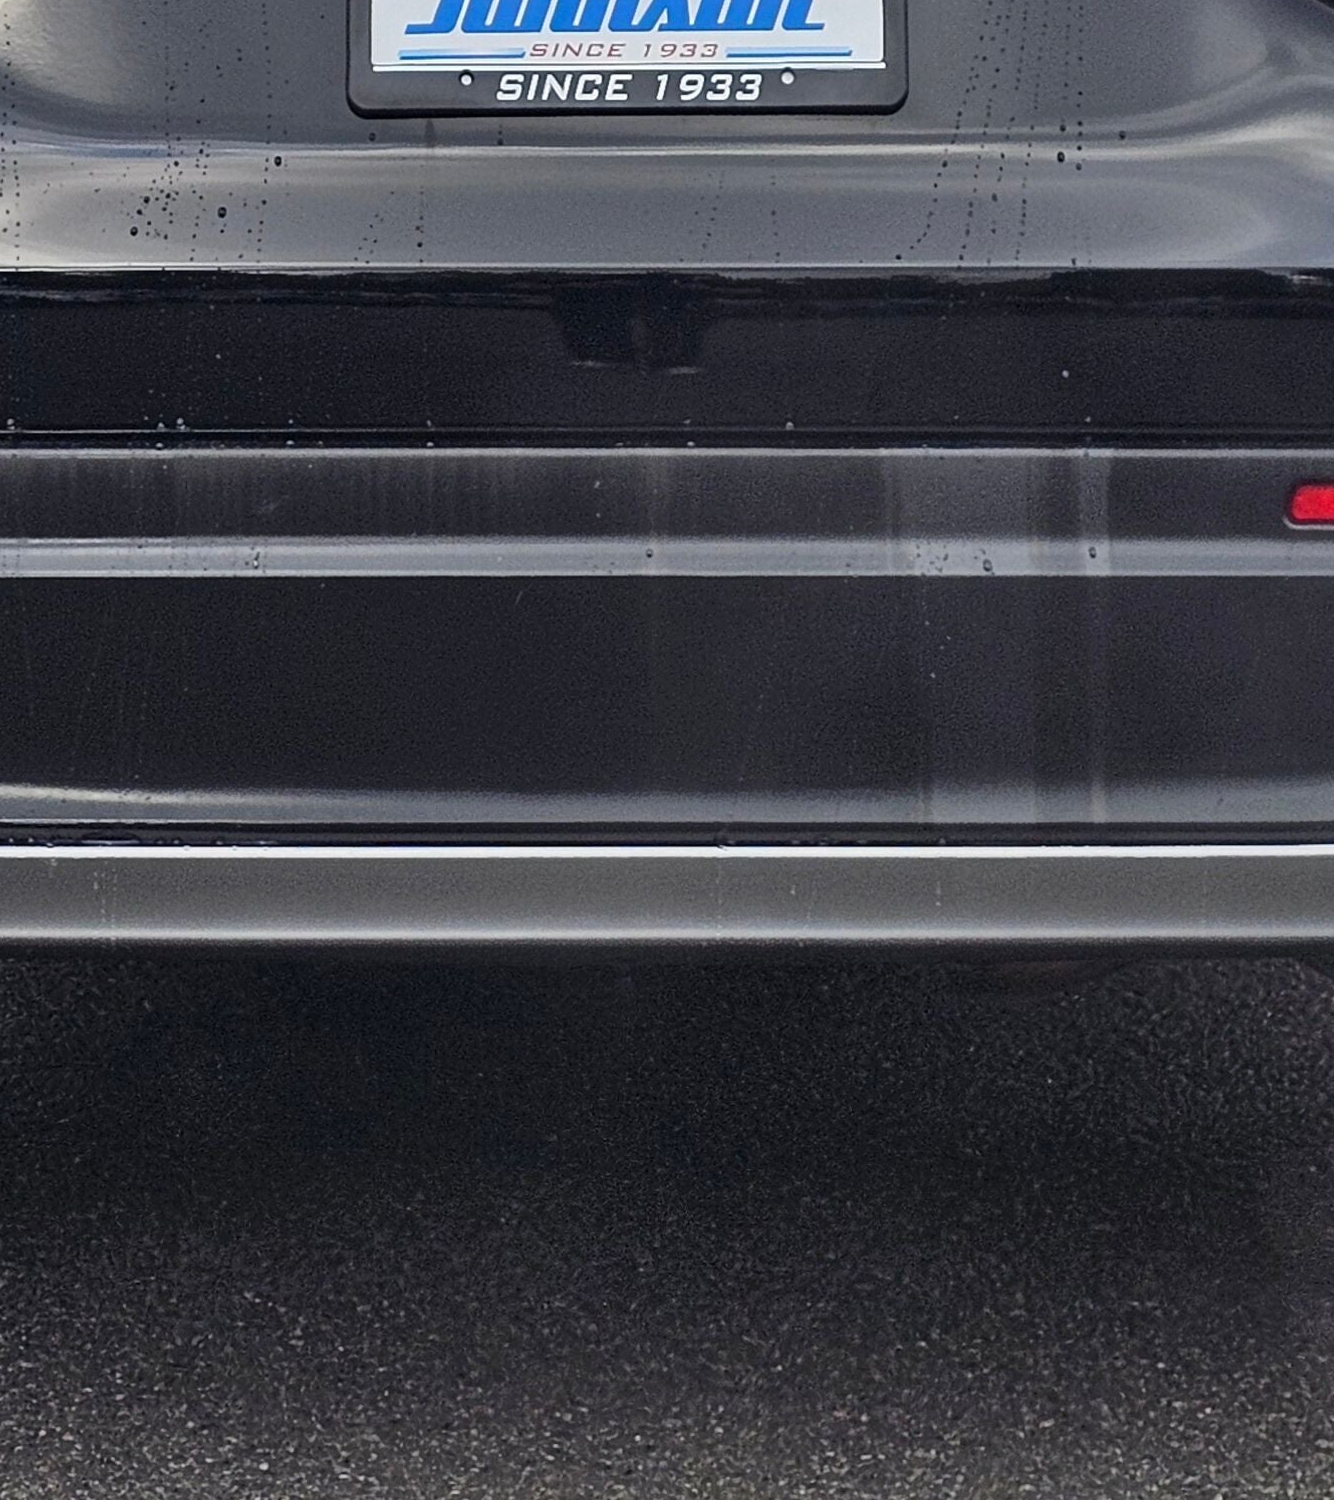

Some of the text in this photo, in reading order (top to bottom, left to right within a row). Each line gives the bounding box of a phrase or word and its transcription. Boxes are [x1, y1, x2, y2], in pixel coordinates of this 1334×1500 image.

[529, 42, 720, 58] SINCE 1933
[496, 73, 763, 101] SINCE 1933
